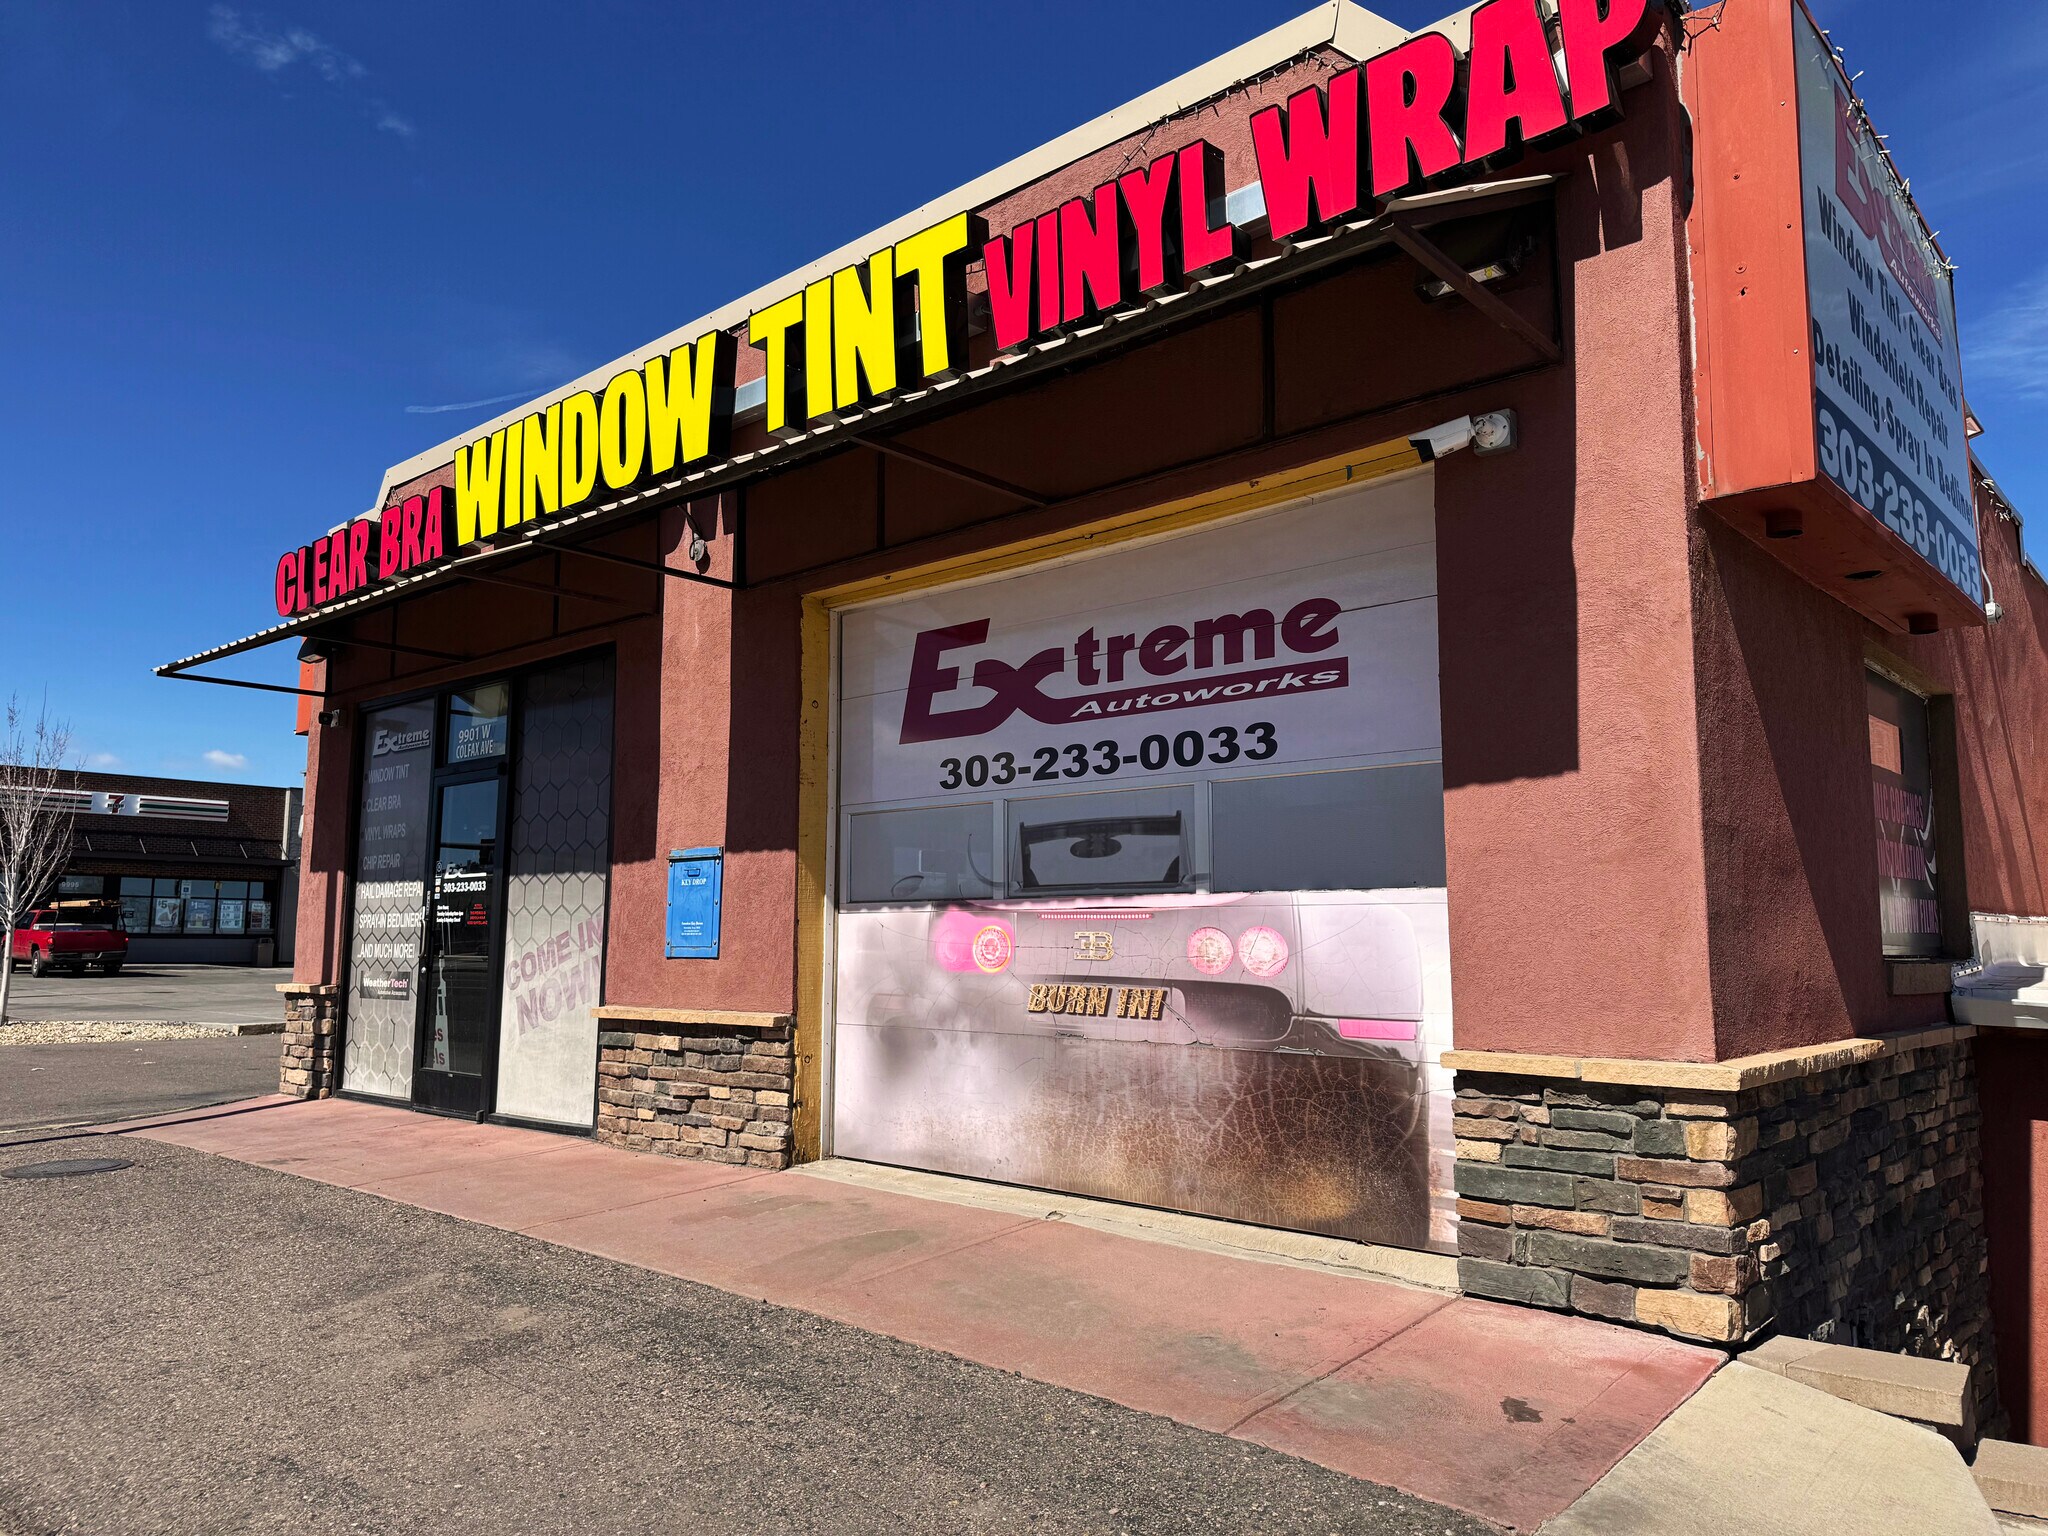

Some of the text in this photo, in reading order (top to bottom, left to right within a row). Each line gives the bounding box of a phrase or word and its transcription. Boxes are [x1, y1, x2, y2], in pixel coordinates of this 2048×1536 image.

[275, 0, 1648, 617] CLEAR BRA WINDOW TINT VINYL WRAP
[1817, 185, 1958, 413] Window Tint Clear Bras
[1890, 258, 1943, 342] Autoworks
[1847, 287, 1949, 450] Windshield Repair
[1812, 316, 1880, 434] Detailing
[1885, 396, 1921, 475] Spray
[1924, 439, 1936, 485] In
[1818, 407, 1982, 605] 303-233-0033
[900, 597, 1342, 745] Extreme
[1069, 667, 1341, 719] Autoworks
[372, 729, 430, 756] Extreme
[458, 724, 492, 744] 9901 W
[455, 739, 494, 759] COLFAX AVE
[938, 721, 1279, 790] 303-233-0033
[368, 763, 410, 784] WINDOW TINT
[366, 794, 402, 813] CLEAR BRA
[364, 822, 406, 841] VINYL WRAPS
[362, 853, 401, 871] CHIP REPAIR
[360, 881, 424, 900] HAIL DAMAGE REPAI
[443, 880, 487, 893] 303-233-0033
[692, 878, 707, 886] DROP
[359, 913, 387, 929] SPRAY-IN
[374, 943, 393, 959] MUCH
[393, 943, 415, 959] MORE!
[506, 930, 573, 991] COME
[363, 977, 409, 988] WeatherTech
[1028, 984, 1113, 1018] BURN
